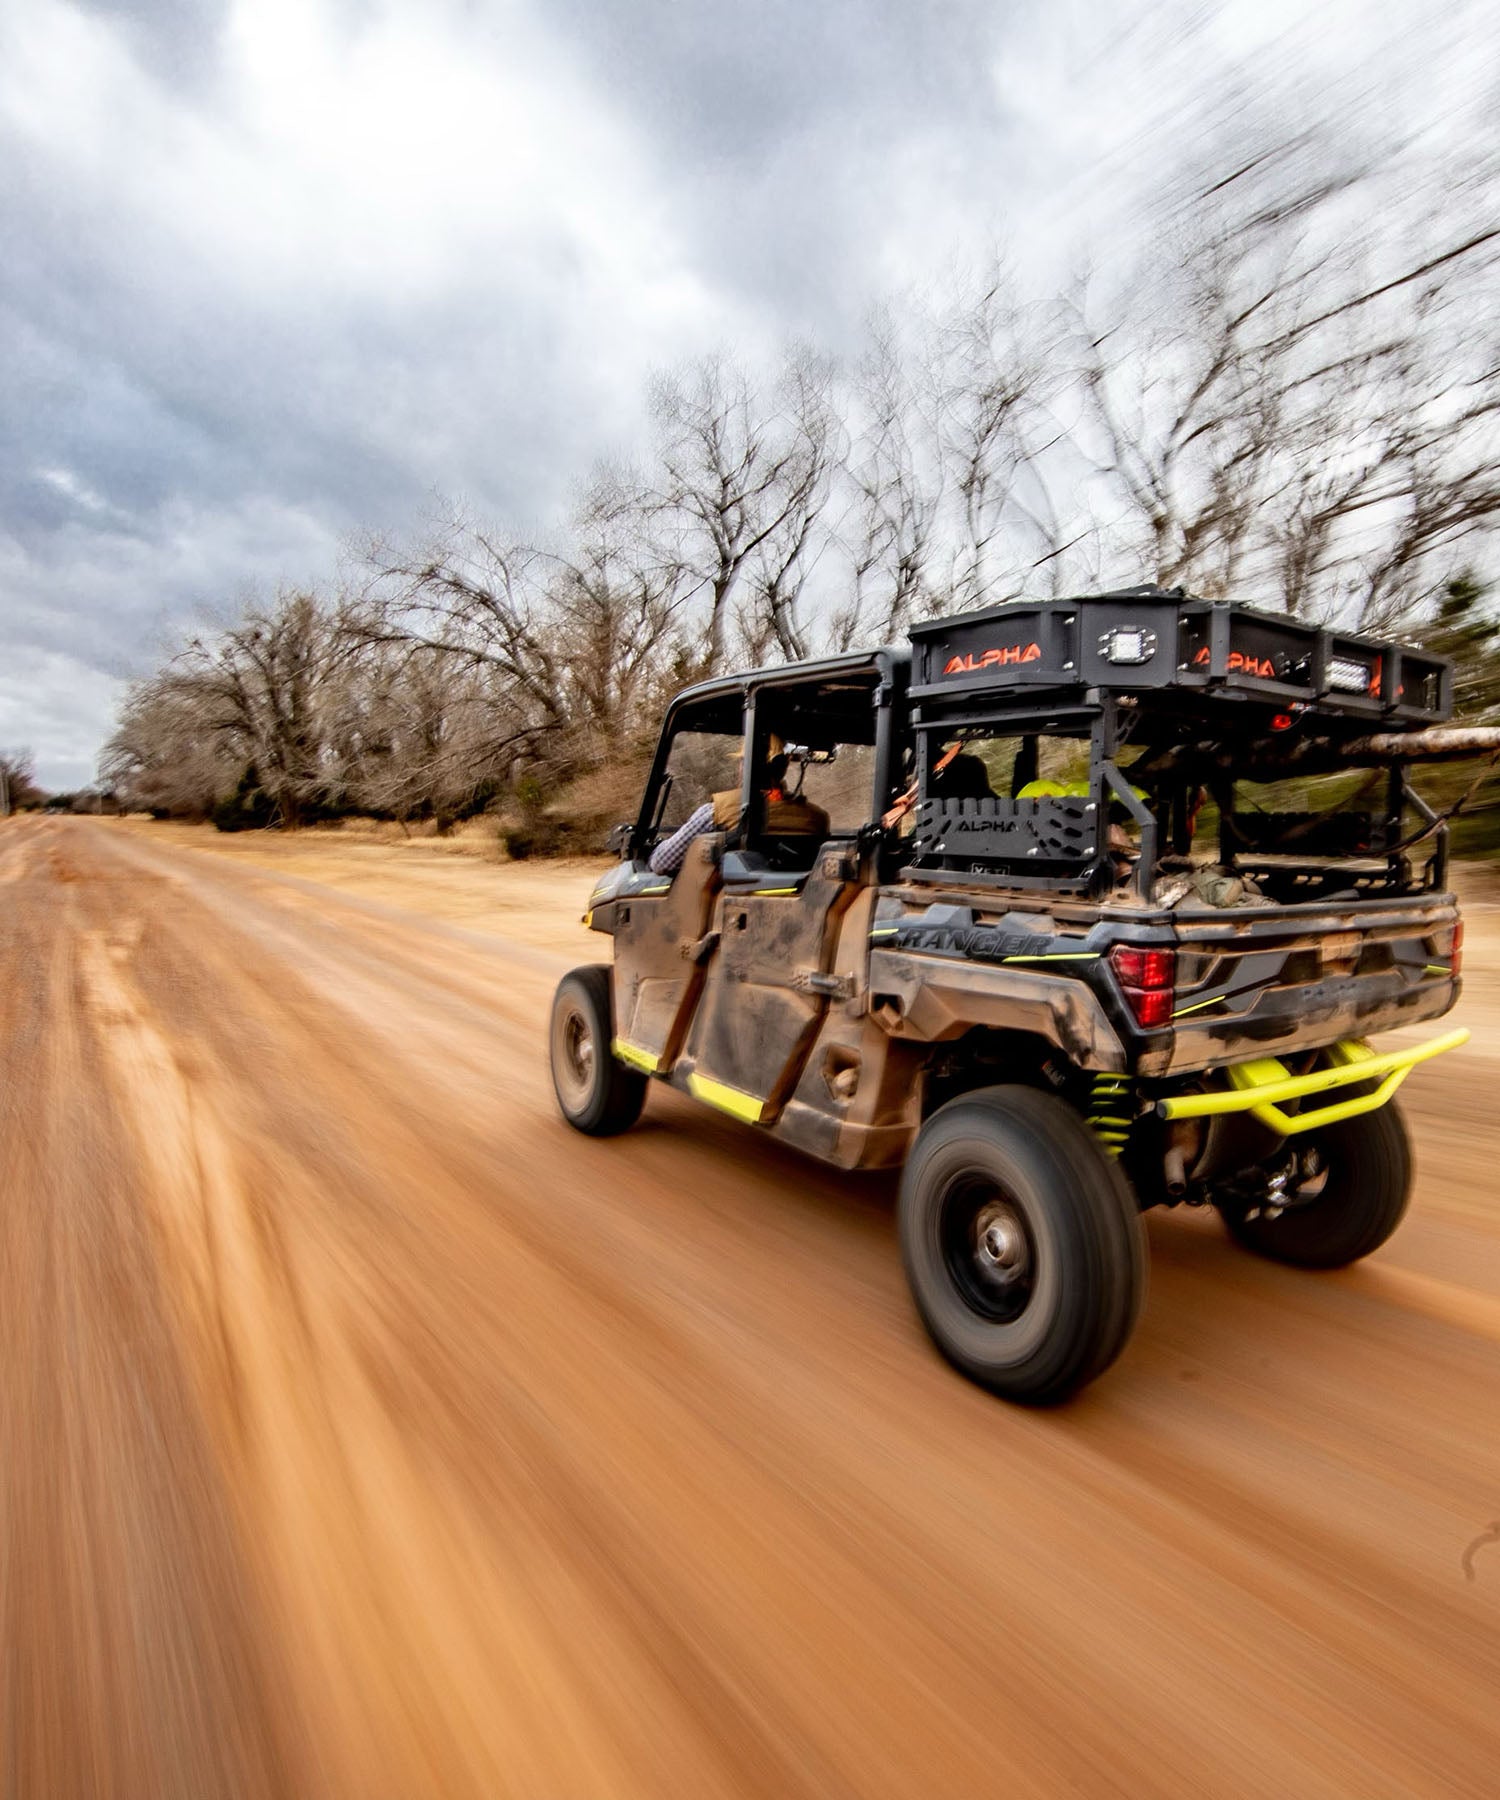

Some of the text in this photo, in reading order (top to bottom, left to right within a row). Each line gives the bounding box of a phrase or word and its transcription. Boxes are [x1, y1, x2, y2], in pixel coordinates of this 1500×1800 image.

[943, 642, 1041, 674] ALPHA
[1193, 645, 1275, 677] APHA
[957, 820, 1018, 833] ALPHA
[898, 928, 1054, 957] RANGER
